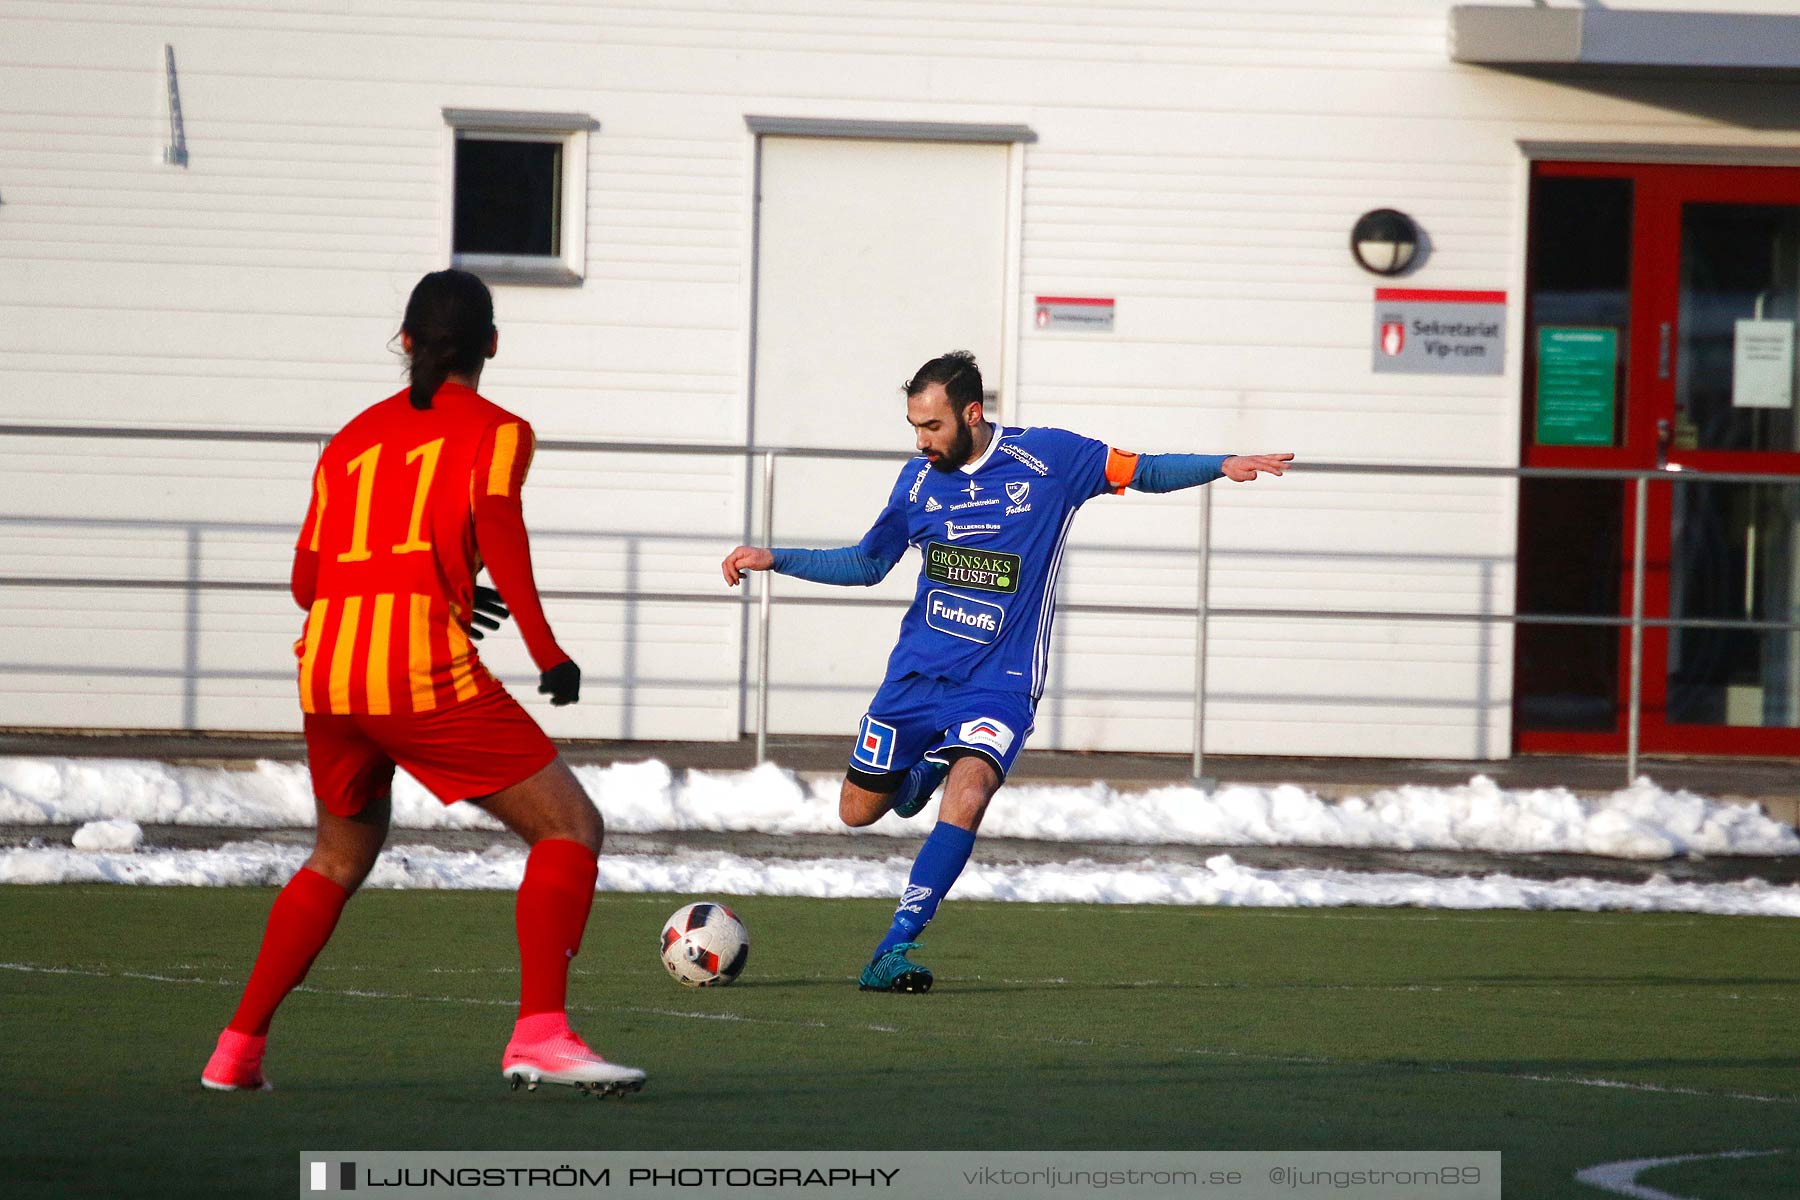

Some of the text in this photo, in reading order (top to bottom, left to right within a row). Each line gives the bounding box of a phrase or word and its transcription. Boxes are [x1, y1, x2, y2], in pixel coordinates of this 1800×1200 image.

[1412, 320, 1499, 338] Sekretariat
[1424, 341, 1487, 358] Vip-rum
[997, 445, 1048, 477] PHOTOGRAPHY
[337, 437, 445, 563] 11
[949, 499, 1000, 511] Svensk Direktreklam
[1005, 503, 1032, 517] Fotboll
[931, 549, 1011, 573] GRÖNSAKS
[946, 566, 998, 586] HUSET
[932, 599, 996, 632] Furhoffs
